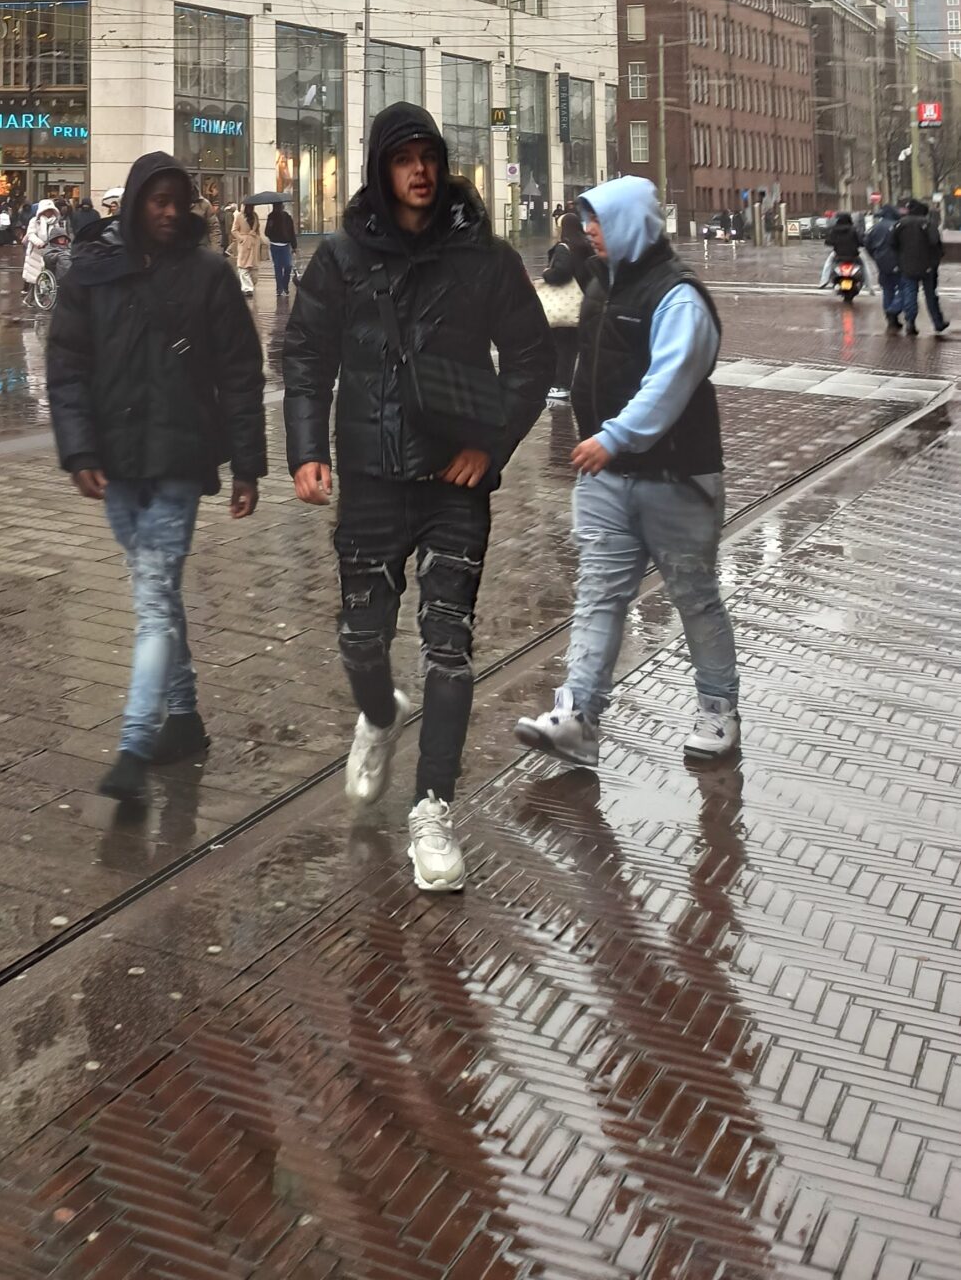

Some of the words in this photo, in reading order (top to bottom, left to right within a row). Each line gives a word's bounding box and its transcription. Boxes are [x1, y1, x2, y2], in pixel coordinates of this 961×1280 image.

[560, 86, 568, 129] PRIMARK
[53, 126, 88, 137] PRIM
[193, 117, 243, 135] PRIMARK
